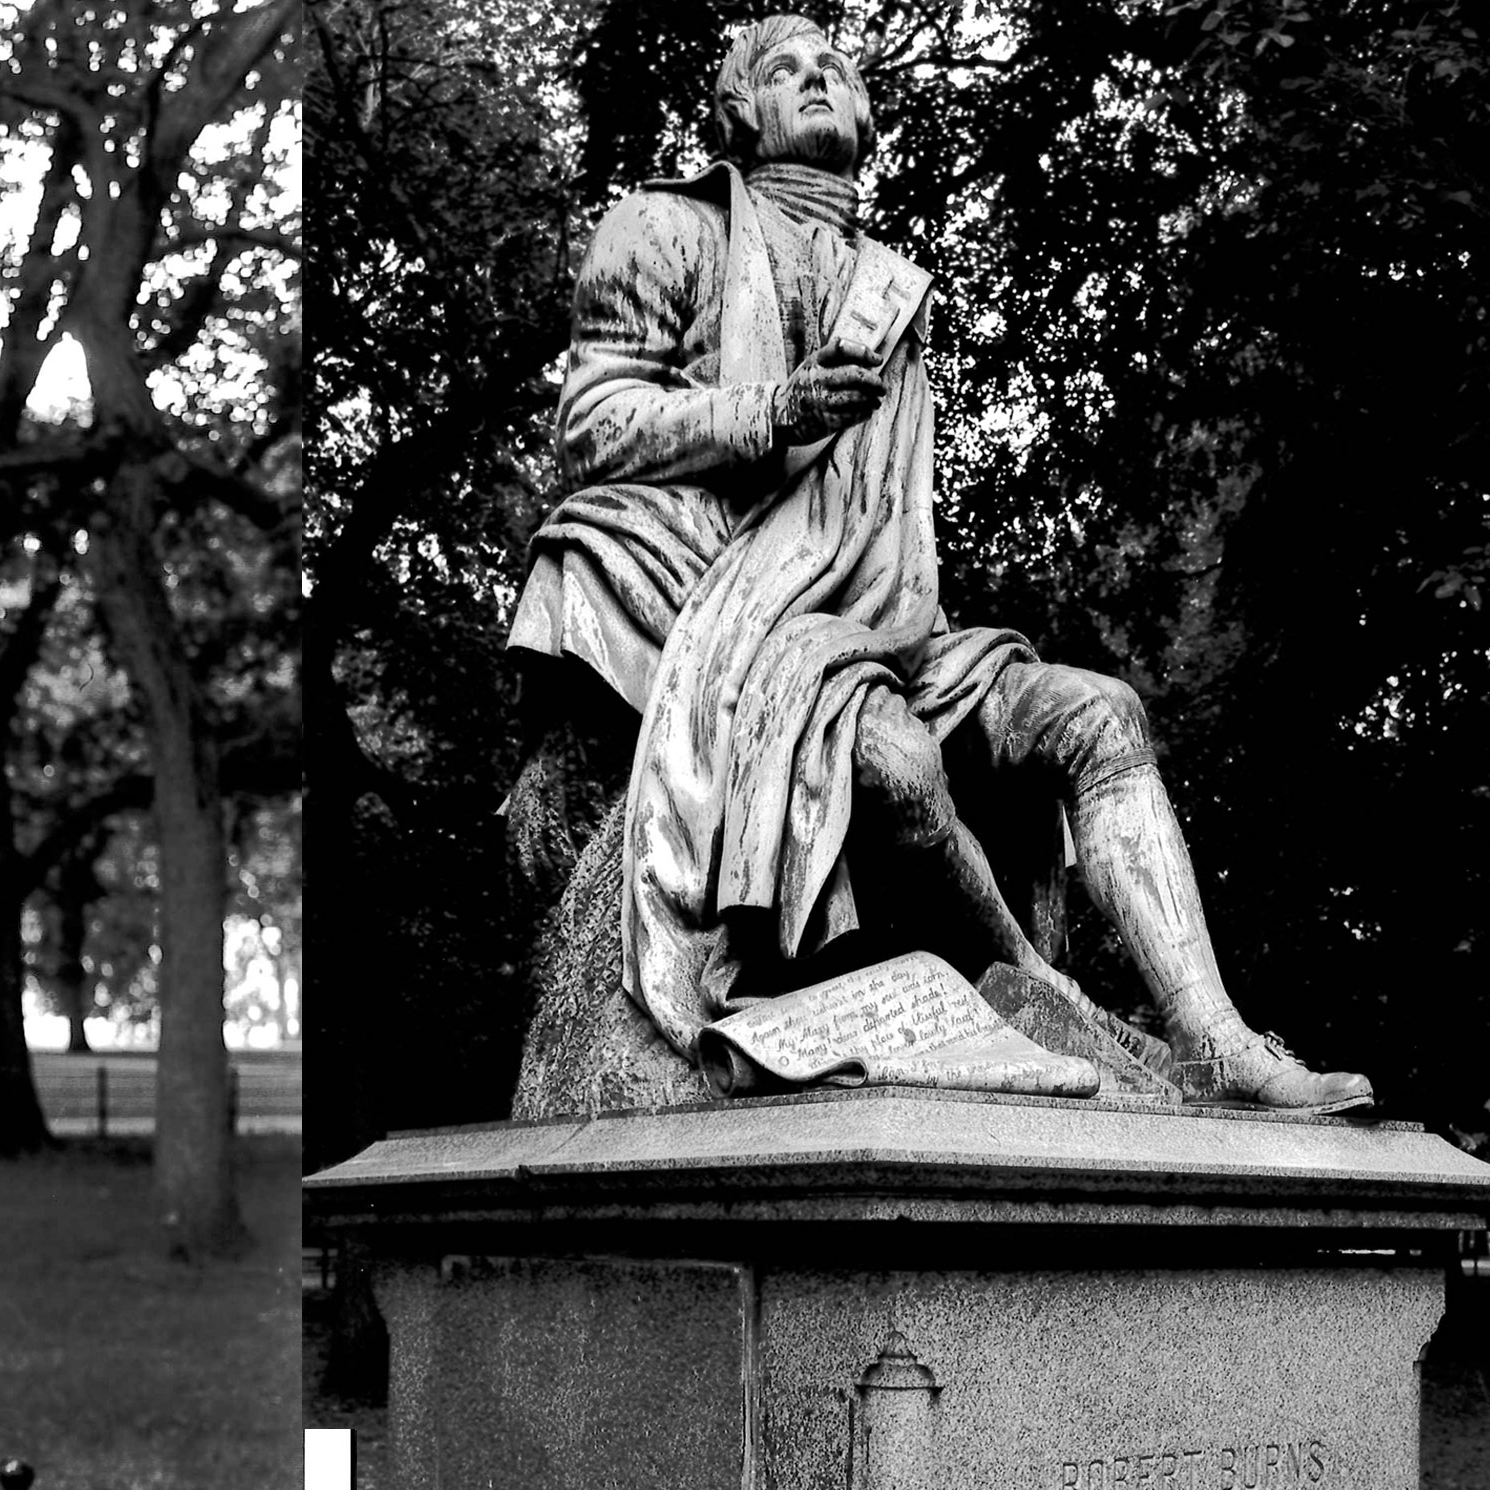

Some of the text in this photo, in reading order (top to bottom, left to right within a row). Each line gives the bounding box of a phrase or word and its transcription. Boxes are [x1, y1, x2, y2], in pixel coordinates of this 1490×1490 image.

[891, 970, 910, 983] day
[862, 1001, 906, 1034] departed
[1061, 1441, 1327, 1490] ROBERT BURNS
